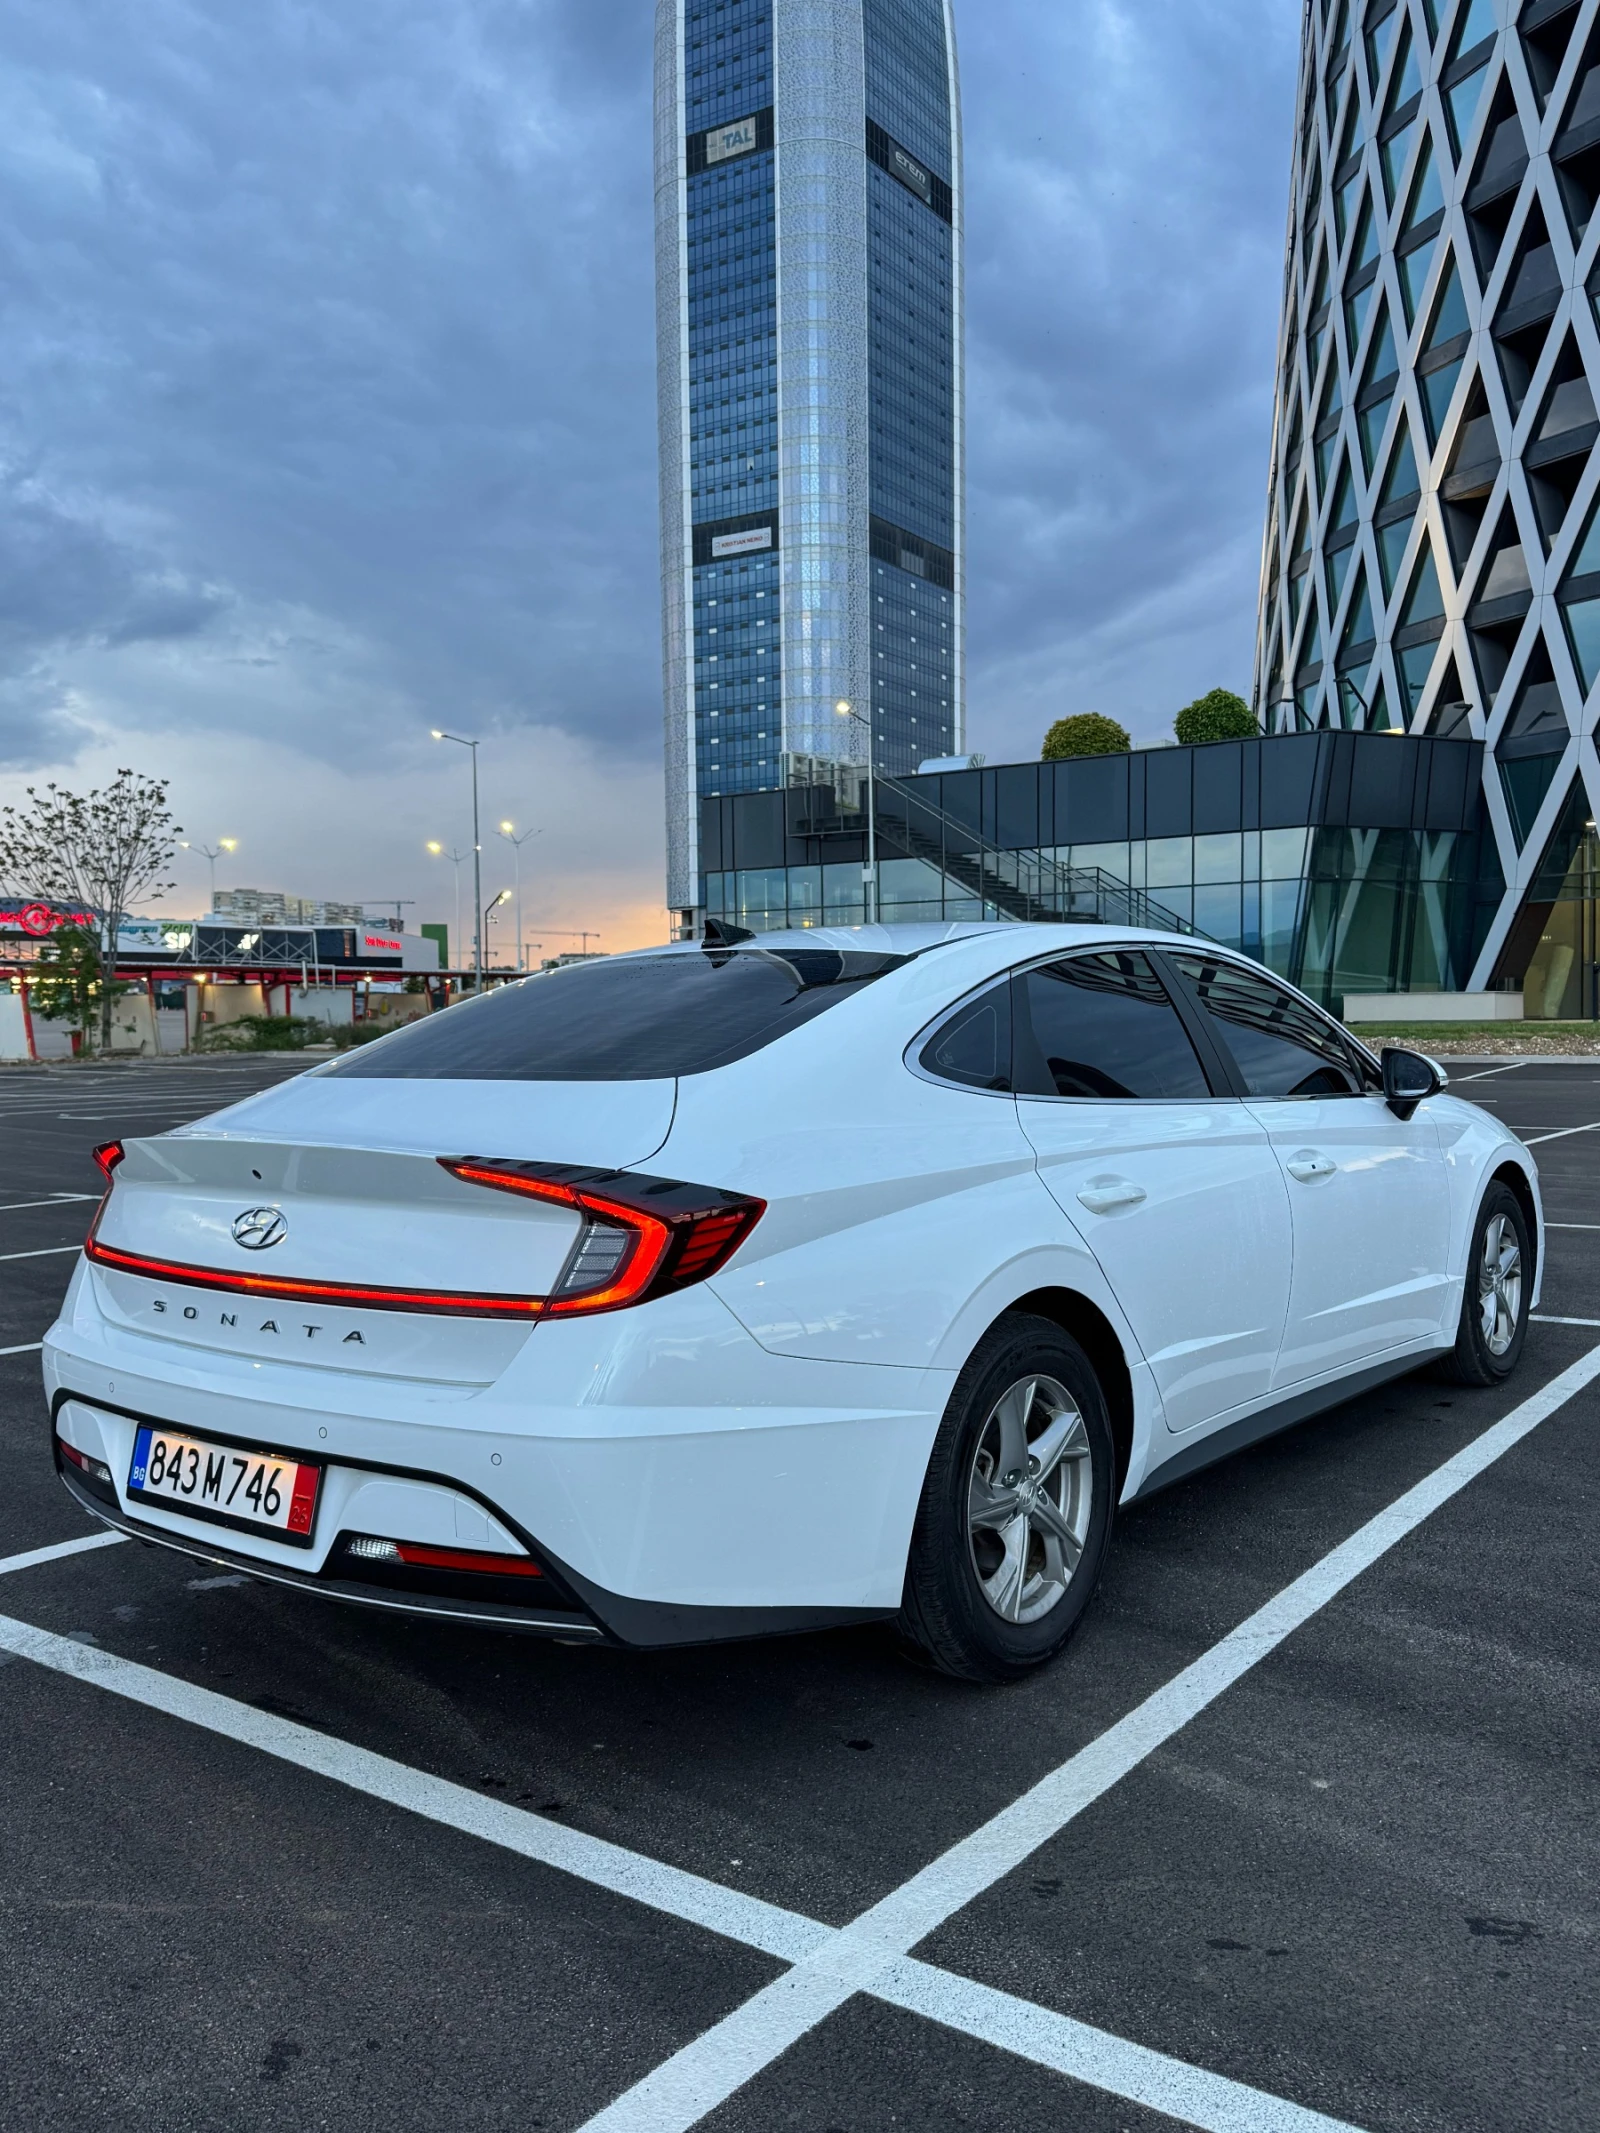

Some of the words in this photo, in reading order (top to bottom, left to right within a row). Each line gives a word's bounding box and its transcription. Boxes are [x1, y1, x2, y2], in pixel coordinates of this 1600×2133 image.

[722, 127, 753, 149] TAL
[153, 1300, 366, 1345] SONATA
[133, 1466, 145, 1481] BG
[291, 1505, 308, 1525] 26
